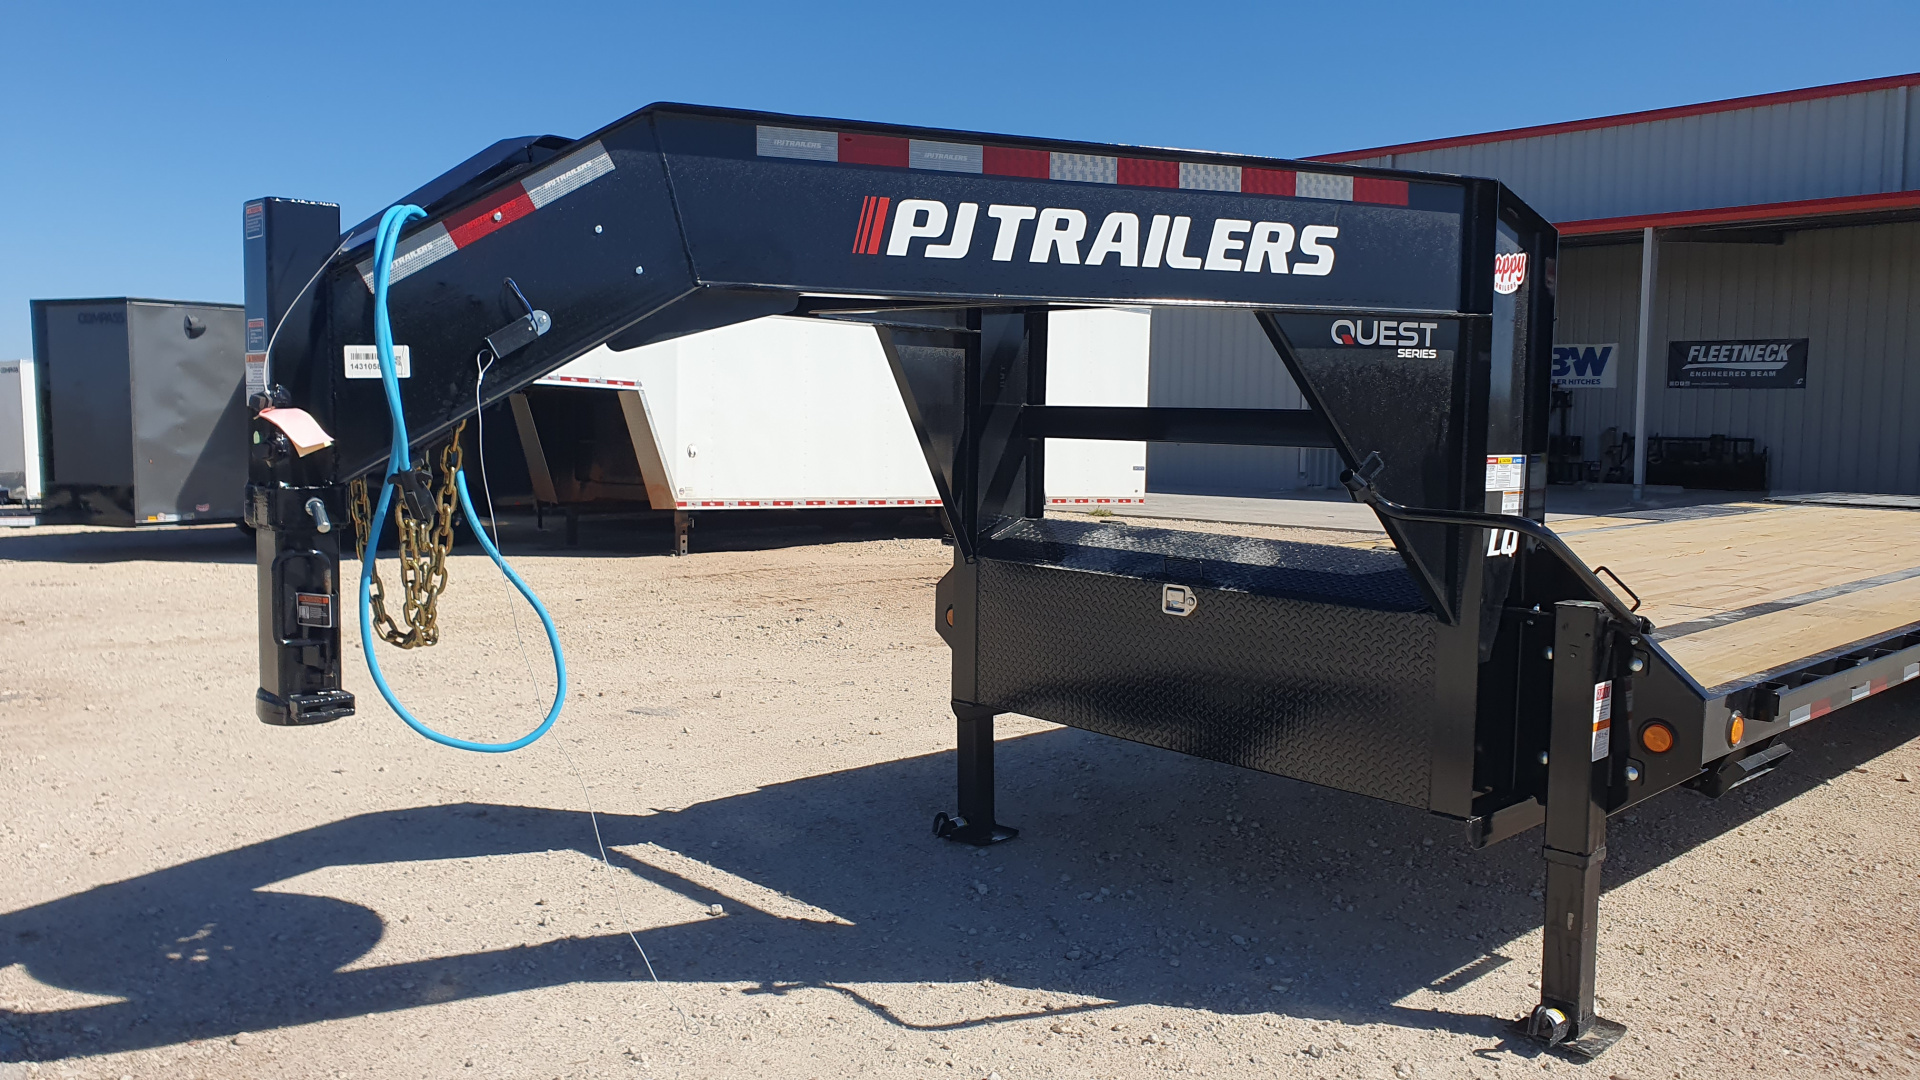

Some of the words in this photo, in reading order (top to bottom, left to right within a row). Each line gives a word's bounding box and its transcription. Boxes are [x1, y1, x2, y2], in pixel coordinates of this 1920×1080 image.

[886, 199, 978, 260] PJ
[987, 204, 1339, 276] TRAILERS
[1494, 255, 1525, 283] appy
[1330, 319, 1438, 347] QUEST
[1397, 348, 1437, 359] SERIES
[1686, 344, 1793, 363] FLEETNECK
[1568, 378, 1601, 386] HITCHES
[1689, 370, 1747, 378] ENGINEERED
[1750, 370, 1777, 378] BEAM
[1486, 528, 1519, 558] LQ
